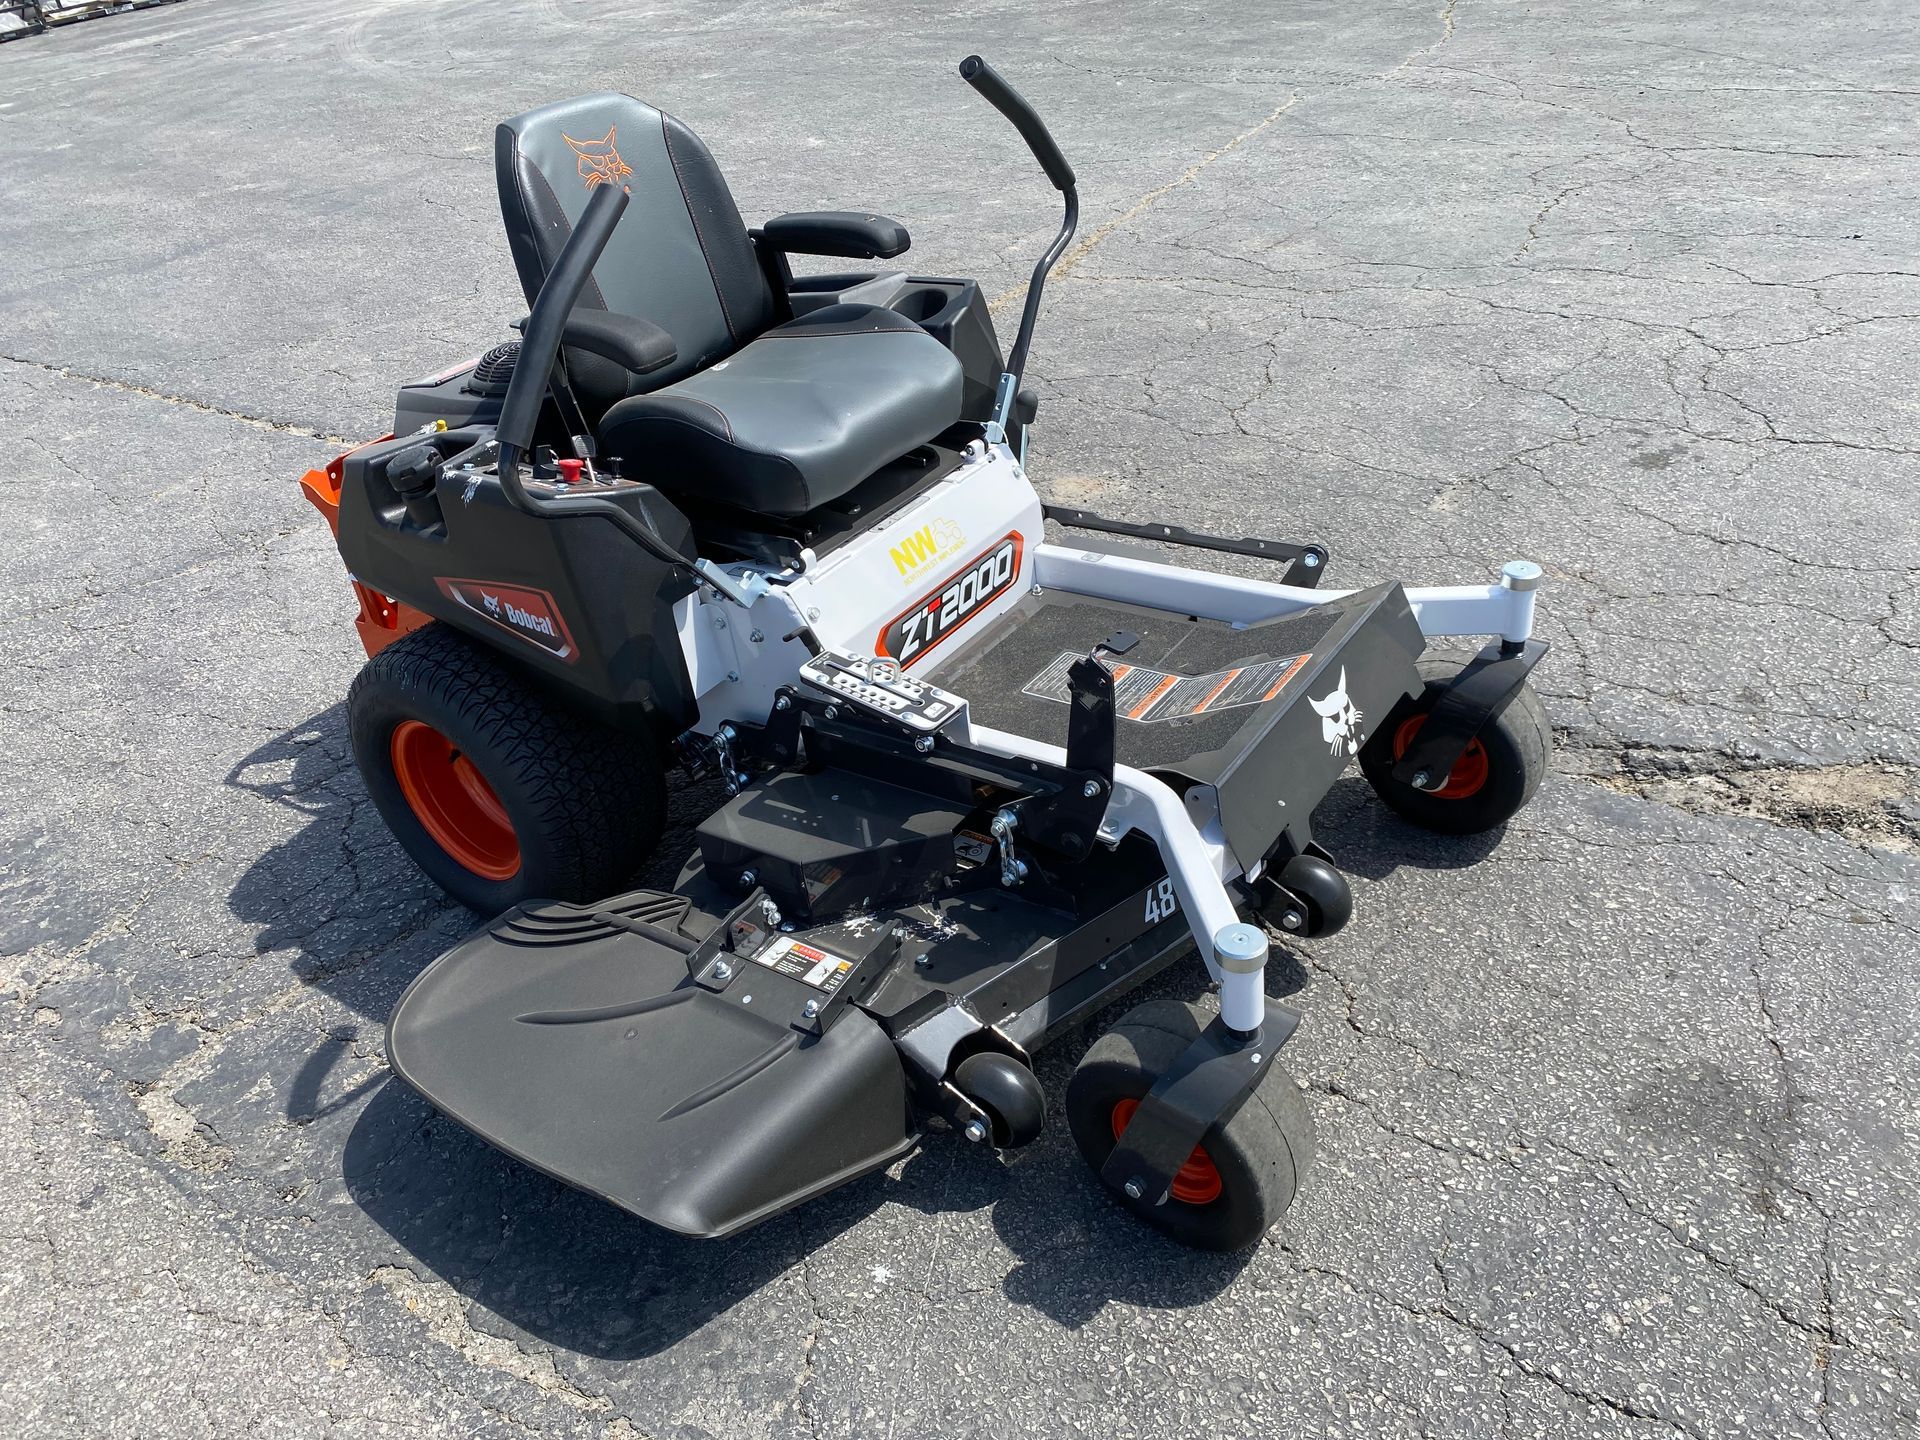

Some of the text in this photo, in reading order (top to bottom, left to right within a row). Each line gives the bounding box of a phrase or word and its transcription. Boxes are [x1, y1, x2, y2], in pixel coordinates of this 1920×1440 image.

[889, 524, 937, 576] NW
[504, 602, 555, 637] Bobcat
[900, 543, 1013, 661] ZT2000
[1144, 877, 1176, 923] 48
